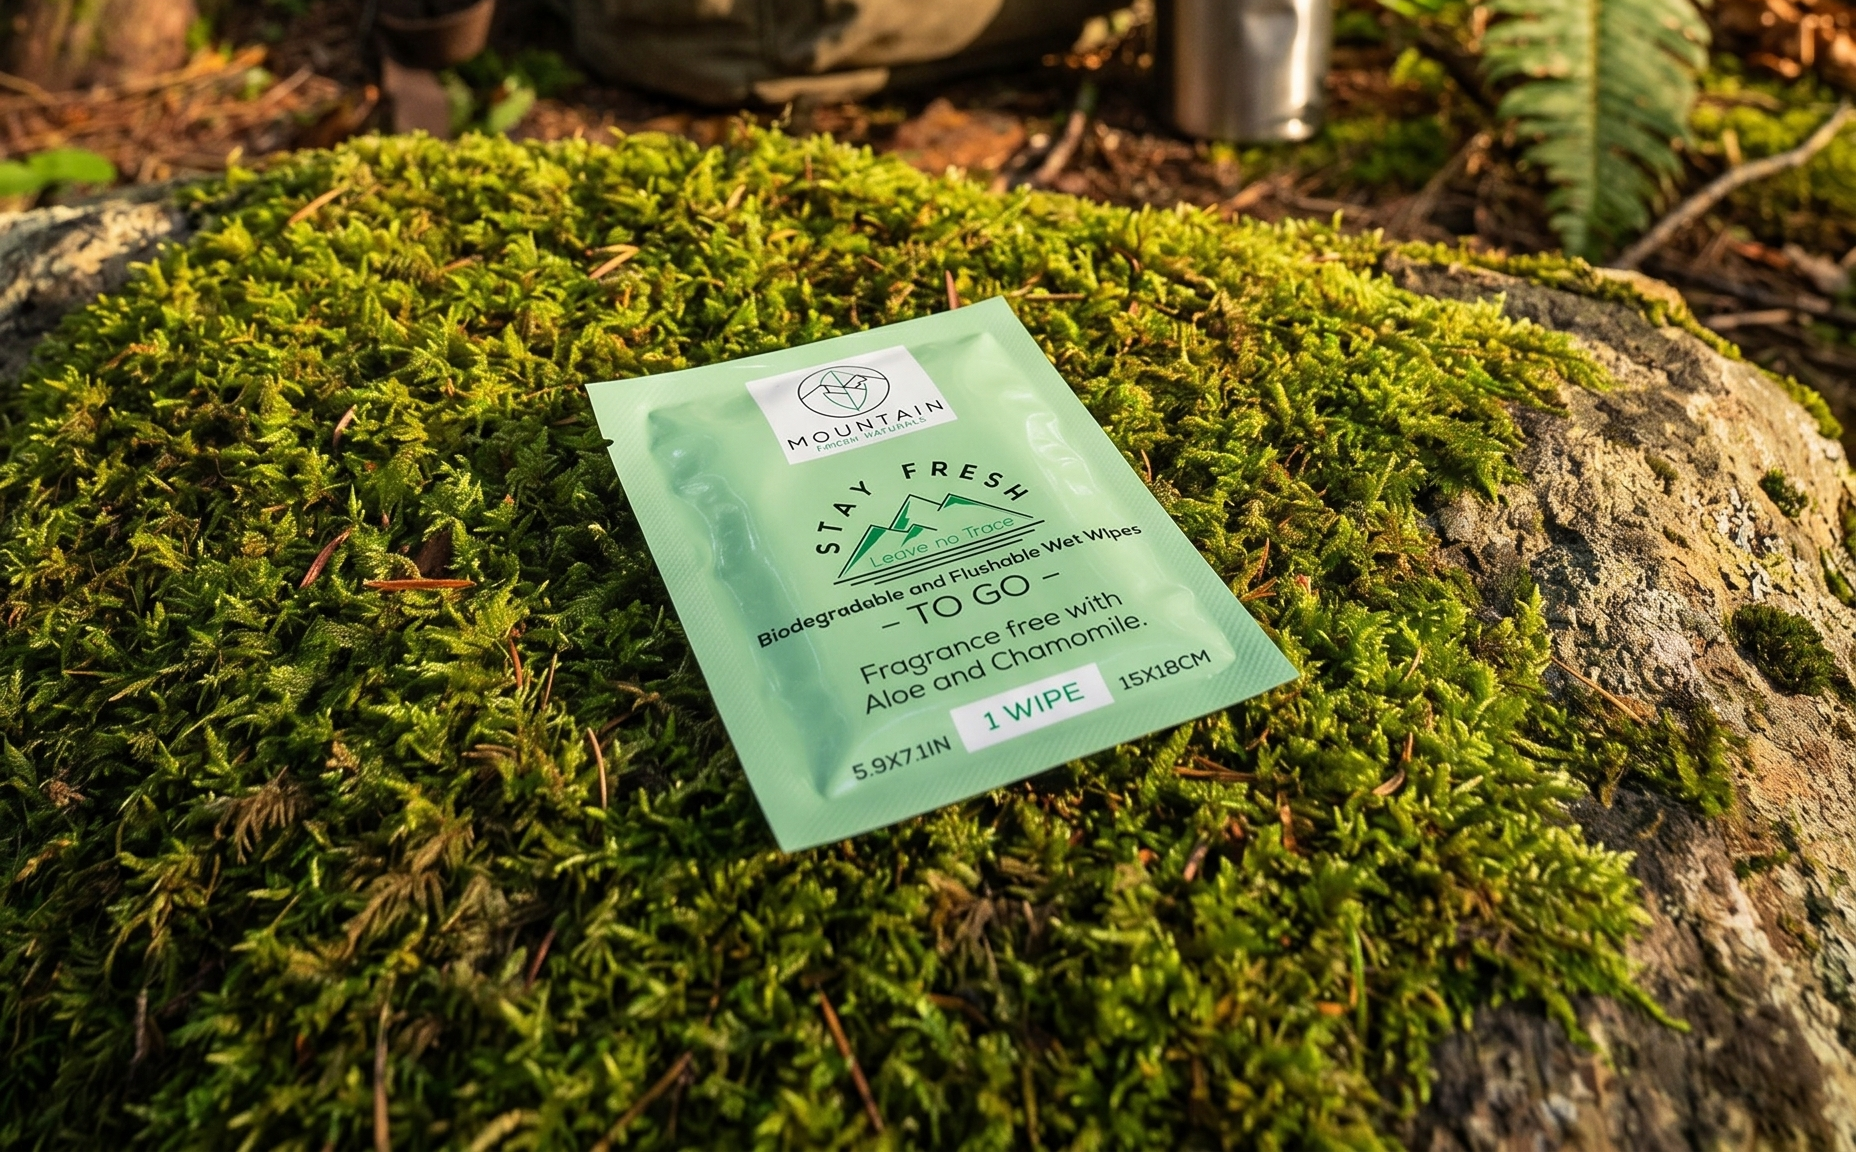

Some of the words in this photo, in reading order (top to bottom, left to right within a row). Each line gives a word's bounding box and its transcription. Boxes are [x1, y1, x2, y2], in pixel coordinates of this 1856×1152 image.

[787, 400, 943, 450] MOUNTAIN
[816, 481, 871, 554] STAY
[901, 461, 1029, 501] FRESH
[870, 540, 928, 569] Leave
[934, 532, 960, 549] no
[962, 515, 1015, 539] Trace
[757, 590, 904, 648] Biodegradable
[909, 574, 946, 595] and
[949, 548, 1040, 583] Flushable
[1040, 534, 1084, 552] Wet
[906, 595, 962, 624] TO
[973, 575, 1030, 605] GO
[860, 631, 1001, 684] Fragrance
[1005, 612, 1060, 638] free
[1065, 592, 1123, 618] with
[866, 684, 925, 715] Aloe
[933, 659, 986, 691] and
[992, 615, 1147, 670] Chamomile.
[1119, 649, 1211, 690] 15X18CM
[984, 711, 1000, 731] 1
[1003, 682, 1085, 721] WIPE
[852, 736, 951, 780] 5.9X7.1IN
